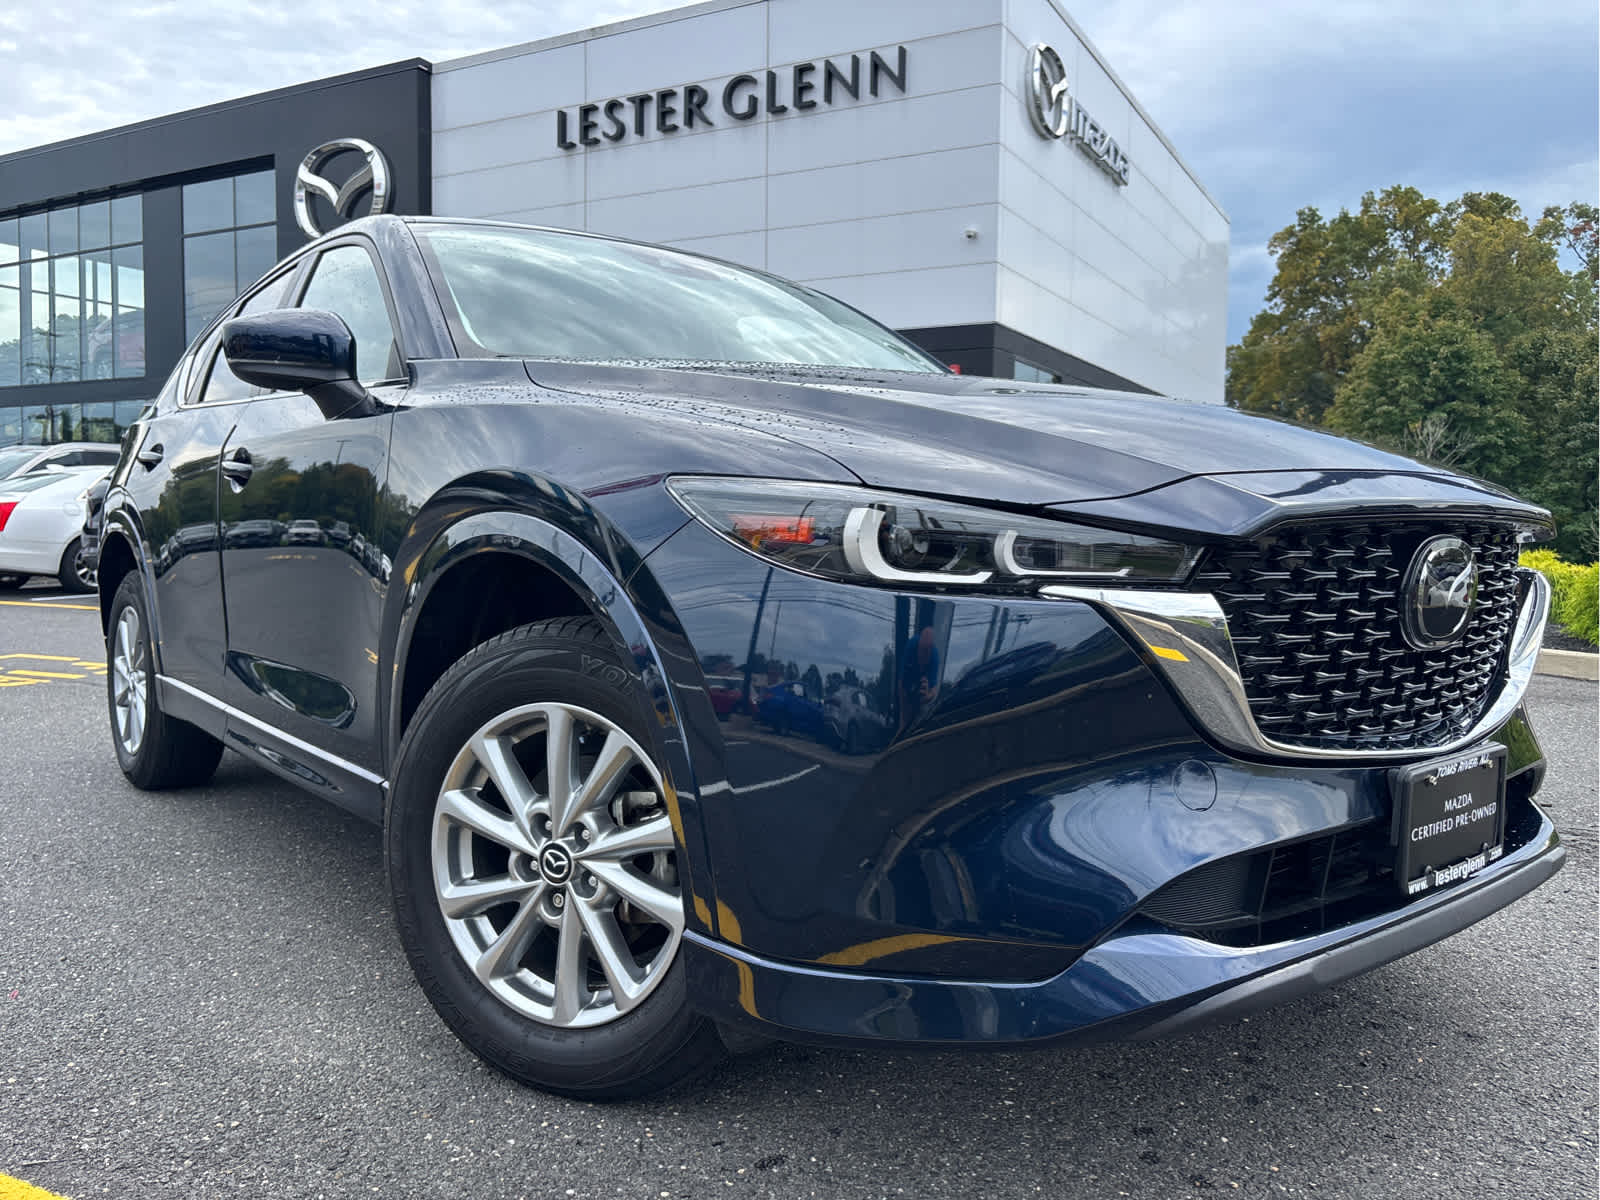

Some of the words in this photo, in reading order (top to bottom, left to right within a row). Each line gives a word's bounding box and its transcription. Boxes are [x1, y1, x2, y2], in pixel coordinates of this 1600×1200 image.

[557, 84, 714, 150] LESTER
[721, 45, 907, 121] GLENN
[1436, 763, 1458, 778] TOMS
[1444, 792, 1473, 813] MAZDA
[1411, 817, 1454, 842] CERTIFIED
[1455, 802, 1497, 827] PRE-OWNED
[1434, 855, 1486, 887] lesterglenn
